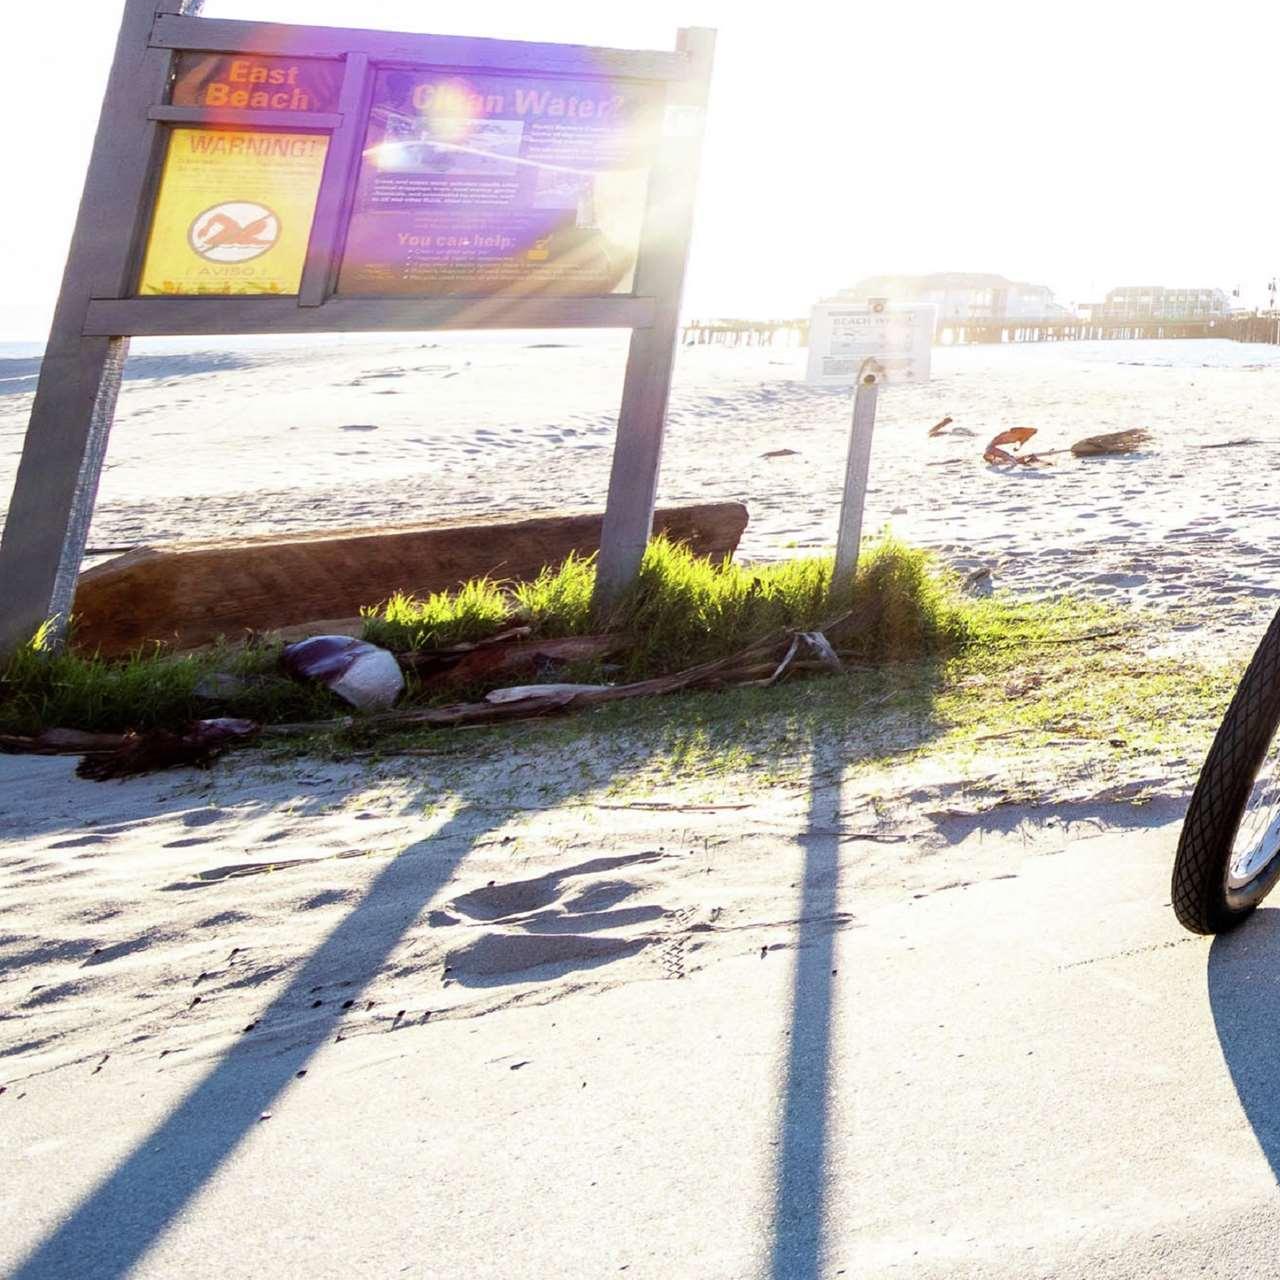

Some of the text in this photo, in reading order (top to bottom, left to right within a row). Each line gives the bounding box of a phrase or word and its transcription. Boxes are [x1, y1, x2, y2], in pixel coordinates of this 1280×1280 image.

[229, 60, 299, 84] East
[205, 83, 309, 110] Beach
[412, 83, 504, 113] Clan
[189, 135, 317, 157] WARNING!
[398, 233, 517, 250] You can help:
